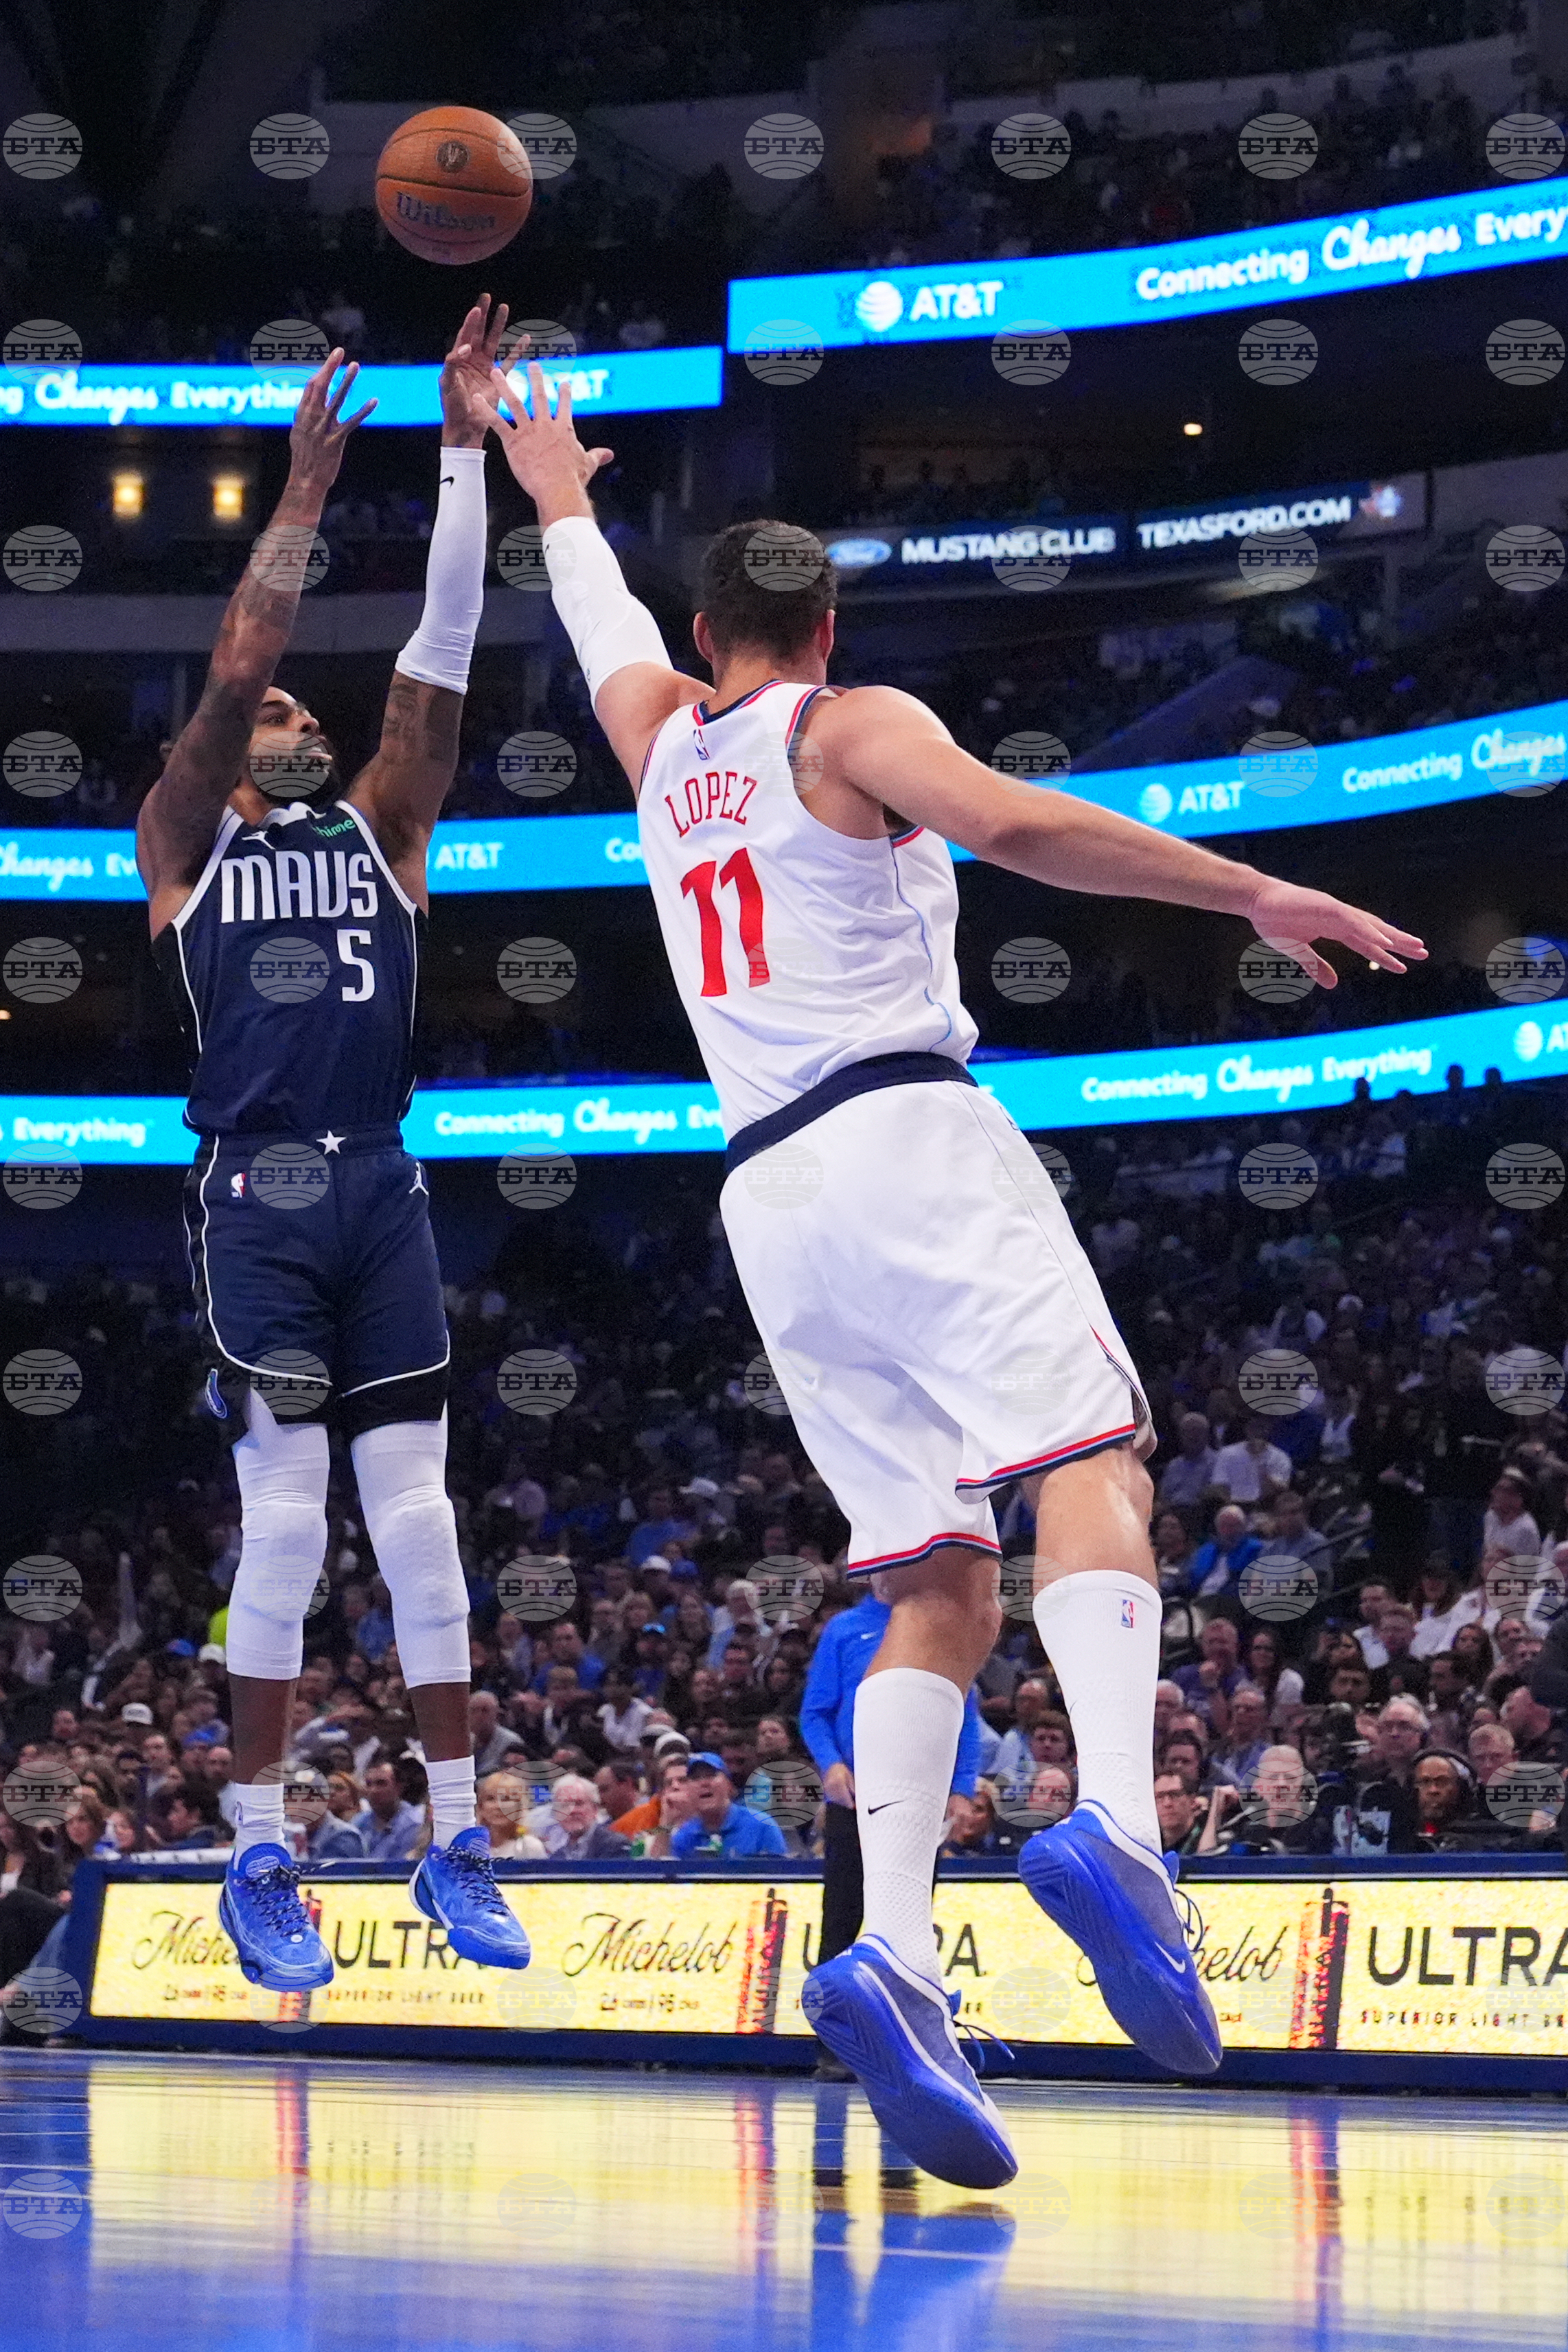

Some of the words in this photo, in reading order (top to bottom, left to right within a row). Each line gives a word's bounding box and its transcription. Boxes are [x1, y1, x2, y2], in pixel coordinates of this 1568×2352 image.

[396, 191, 496, 231] Wilson
[1136, 249, 1310, 301] Connecting
[1322, 218, 1462, 279] Changes
[910, 280, 1004, 321] AT&T
[34, 369, 159, 426] Changes
[171, 381, 307, 415] Everythin
[901, 533, 1038, 564] MUSTANG
[1040, 527, 1116, 555] CLUB
[1136, 496, 1352, 549] TEXASFORD.COM
[1343, 753, 1462, 792] Connecting
[1471, 728, 1567, 777] Changes
[665, 771, 757, 838] LOPEZ
[1178, 781, 1245, 814] AT&T
[0, 842, 93, 891] hanges
[435, 842, 503, 871] AT&T
[680, 847, 770, 997] 11
[336, 929, 376, 1002] 5
[1081, 1071, 1208, 1101] Connecting
[1217, 1054, 1314, 1103] Changes
[1322, 1047, 1432, 1083] Everything
[14, 1117, 146, 1148] Everything
[435, 1110, 564, 1138] Connecting
[574, 1097, 678, 1144] Changes
[132, 1911, 240, 1970] Miche
[335, 1920, 489, 1970] ULTR
[562, 1913, 737, 1977] Michelob
